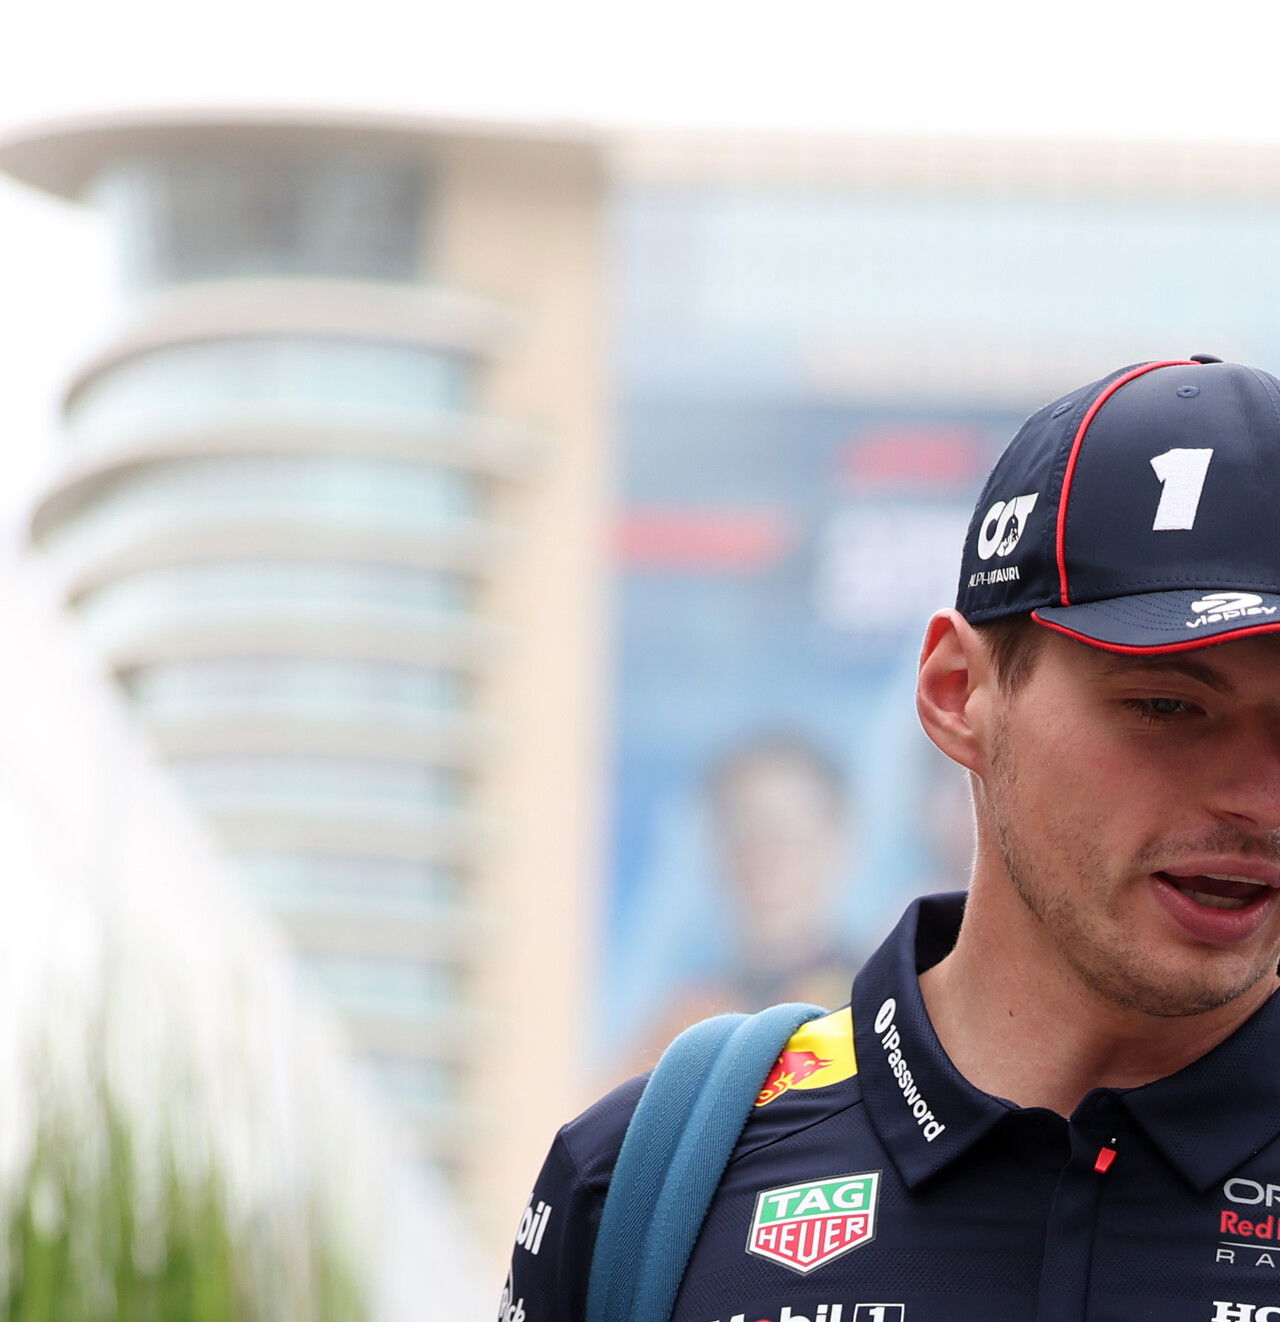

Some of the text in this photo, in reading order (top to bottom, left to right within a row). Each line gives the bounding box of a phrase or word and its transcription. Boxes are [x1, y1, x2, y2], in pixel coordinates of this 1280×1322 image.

[1150, 448, 1213, 530] 1
[881, 1024, 945, 1143] 1Password
[767, 1182, 865, 1218] TAG
[758, 1217, 865, 1264] HEUER
[1220, 1210, 1275, 1238] Red
